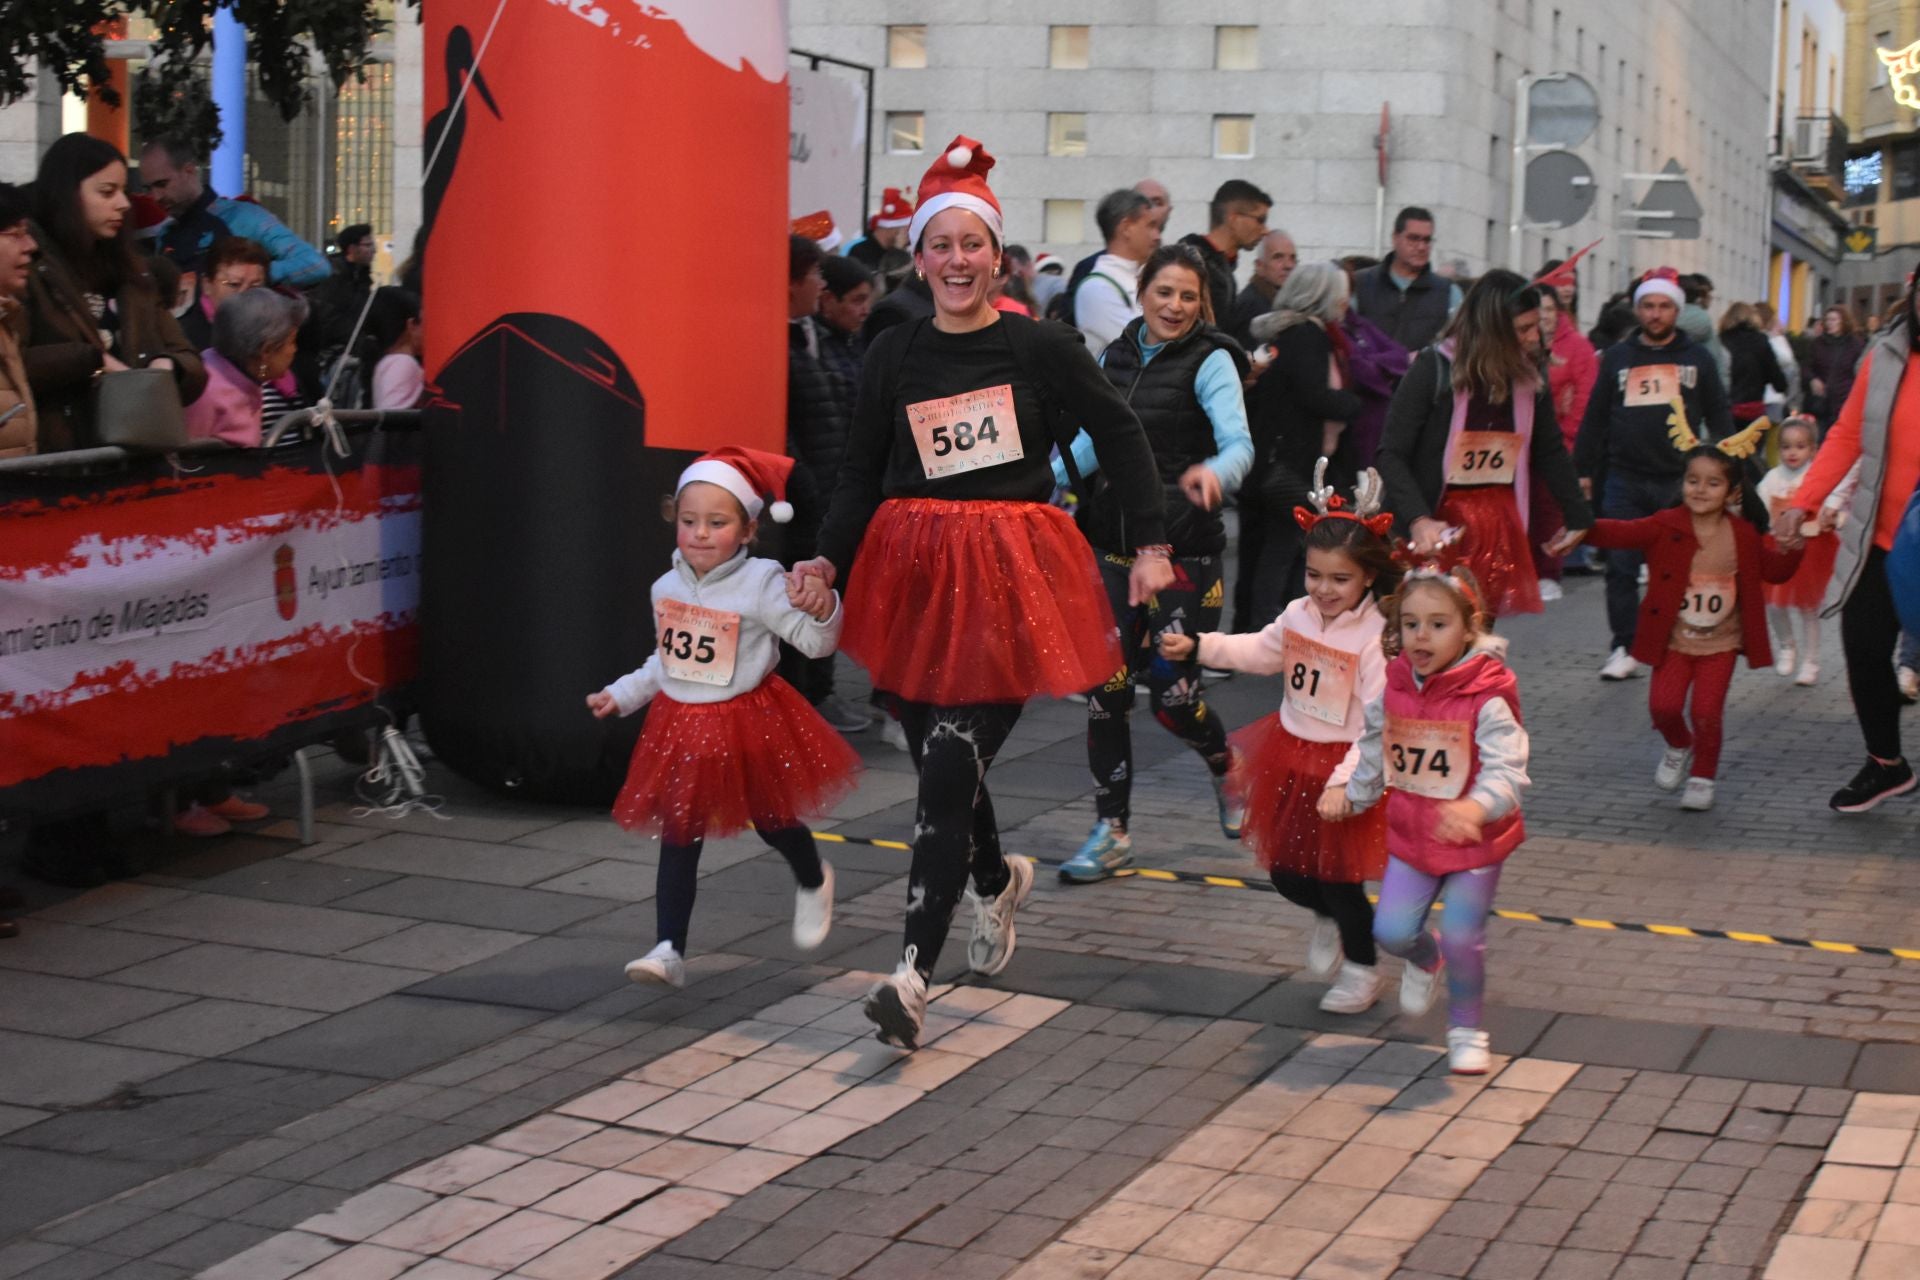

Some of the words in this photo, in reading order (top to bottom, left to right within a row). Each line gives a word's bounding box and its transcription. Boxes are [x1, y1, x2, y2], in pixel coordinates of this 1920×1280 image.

[1640, 379, 1660, 395] 51
[932, 415, 999, 457] 584
[1462, 449, 1505, 471] 376
[0, 616, 82, 657] miento
[87, 606, 114, 641] de
[662, 627, 716, 664] 435
[1291, 662, 1321, 697] 81
[1391, 743, 1451, 778] 374
